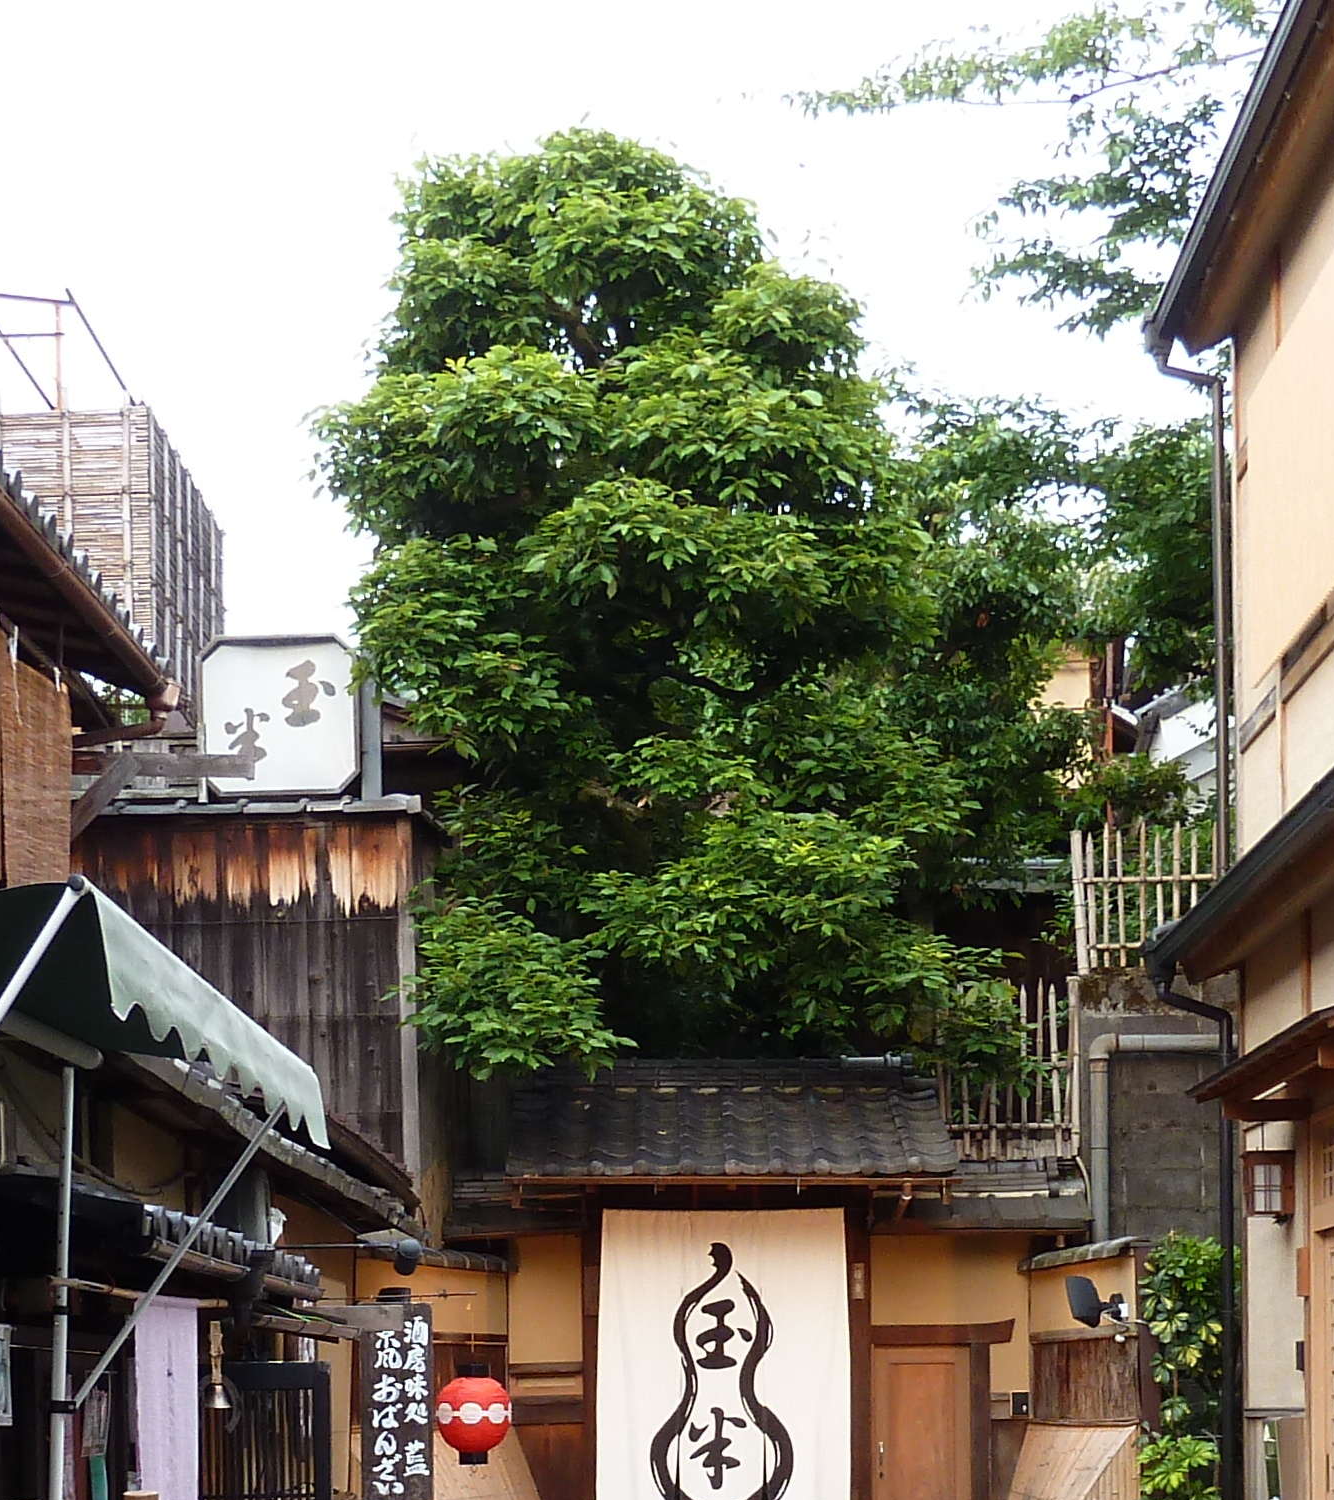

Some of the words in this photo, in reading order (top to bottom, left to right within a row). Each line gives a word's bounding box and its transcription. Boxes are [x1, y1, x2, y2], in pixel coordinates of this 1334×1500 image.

[224, 659, 336, 781] 玉半
[402, 1315, 430, 1425] 酒房味処
[689, 1298, 753, 1490] 玉半
